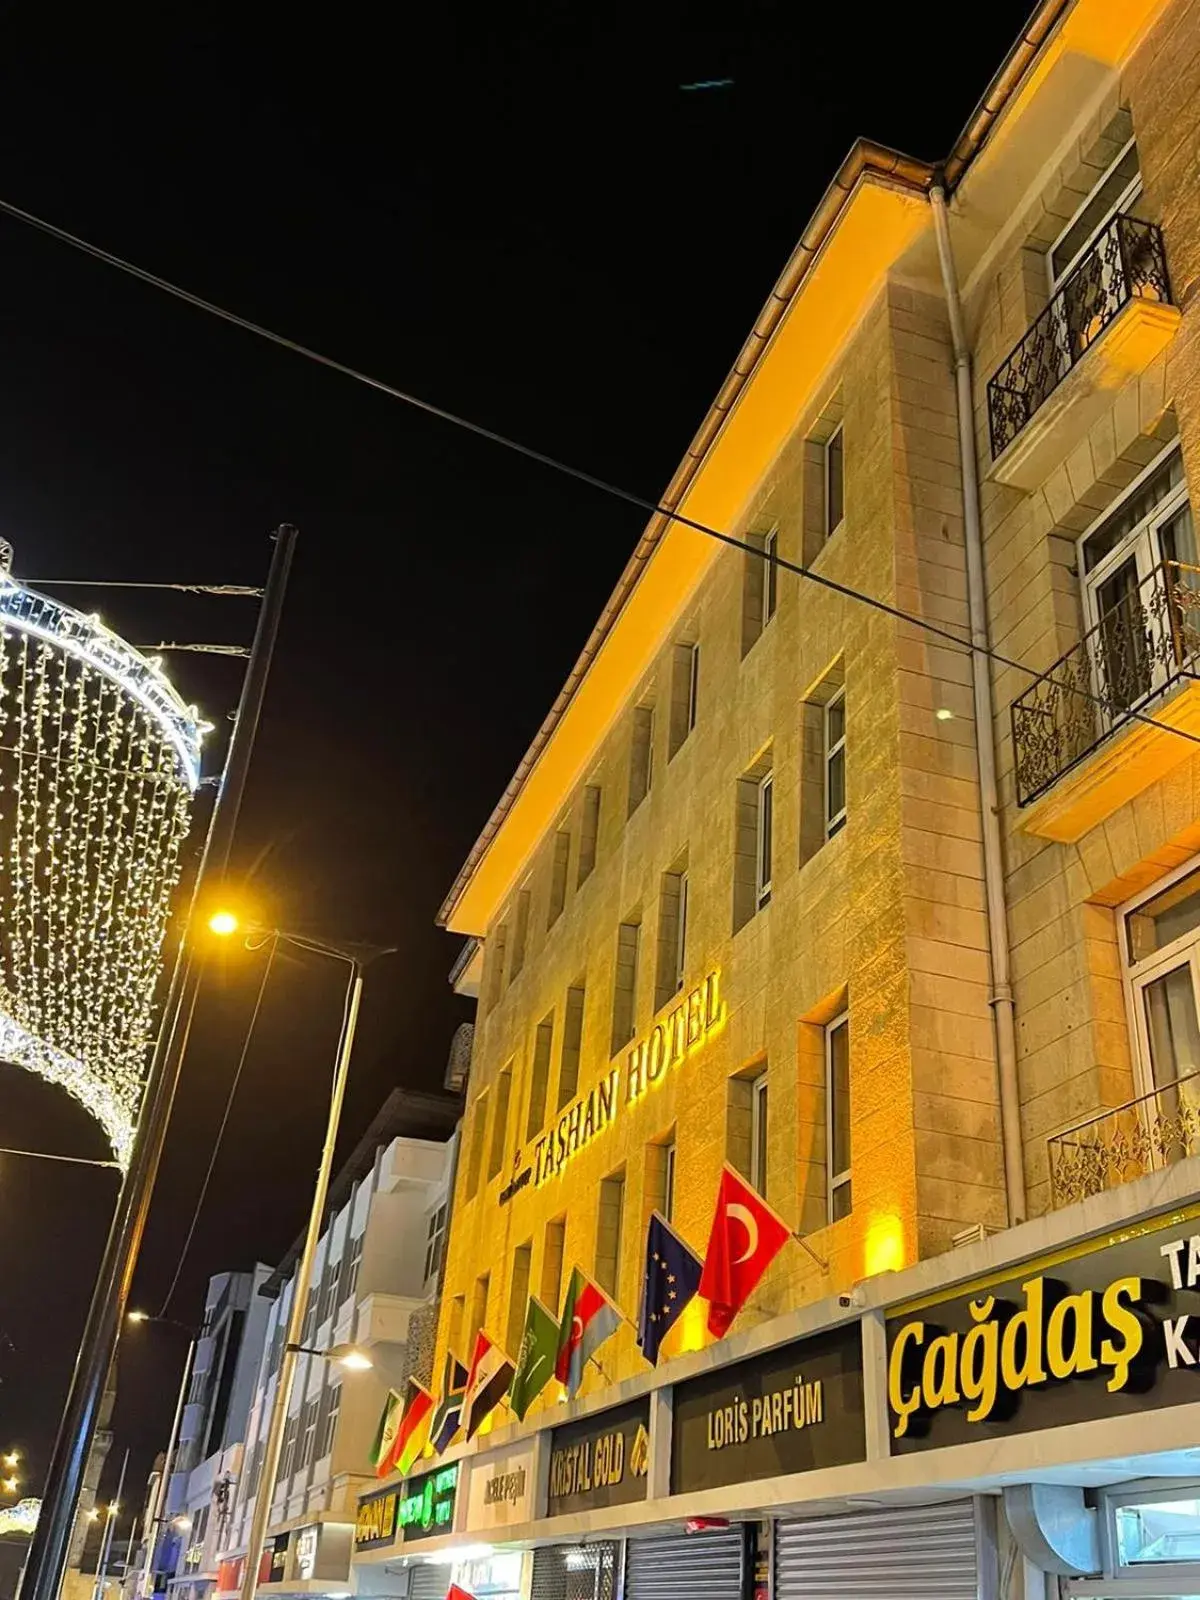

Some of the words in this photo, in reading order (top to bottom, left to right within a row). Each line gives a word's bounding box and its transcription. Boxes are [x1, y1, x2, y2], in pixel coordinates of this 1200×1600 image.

[626, 970, 727, 1106] HOTEL
[889, 1275, 1143, 1439] Çağdaş
[1163, 1314, 1200, 1369] K
[707, 1396, 748, 1449] LORİS
[752, 1375, 823, 1438] PARFÜM
[594, 1432, 624, 1488] GOLD
